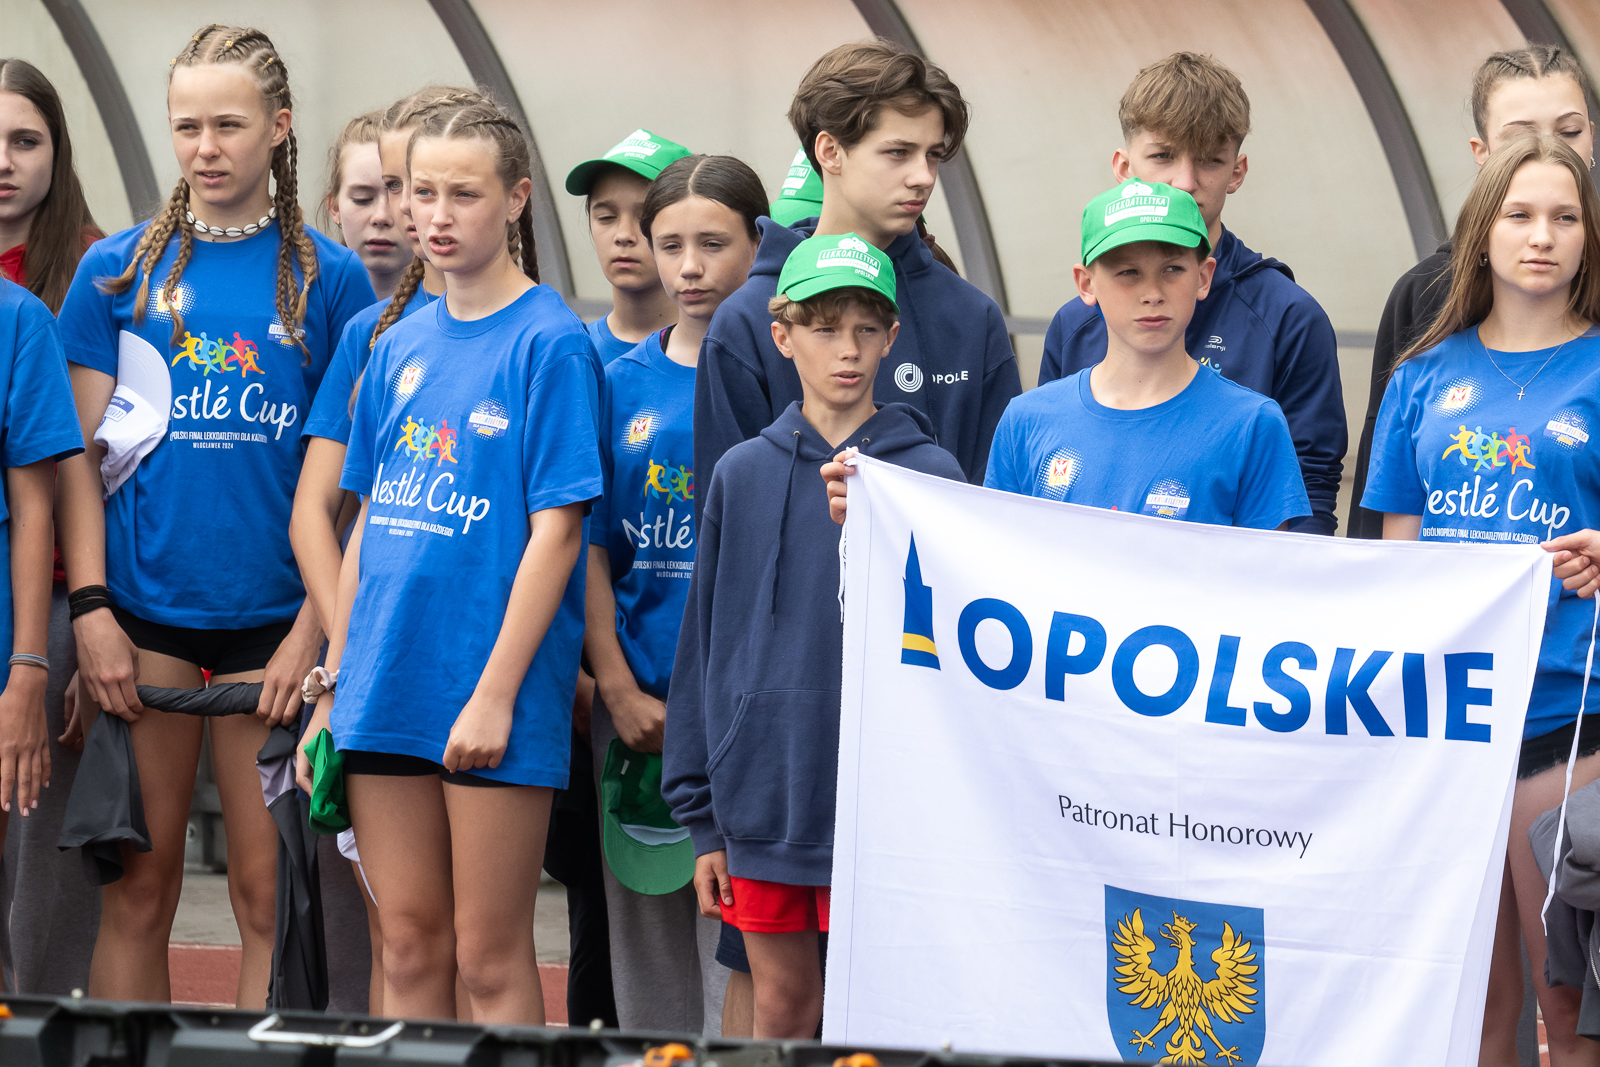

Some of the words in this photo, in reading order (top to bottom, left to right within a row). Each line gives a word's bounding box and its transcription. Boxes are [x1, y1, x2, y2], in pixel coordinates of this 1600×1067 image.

[1107, 196, 1166, 215] LEKKOATLETYKA
[821, 249, 879, 269] LEKKOATLETYKA
[171, 378, 232, 421] stlé
[239, 382, 298, 441] Cup
[427, 472, 491, 535] Cup
[621, 507, 694, 550] Nstlé
[1425, 474, 1500, 519] estlé
[1506, 478, 1571, 542] Cup
[957, 596, 1494, 744] OPOLSKIE
[1058, 794, 1160, 835] Patronat
[1169, 812, 1313, 859] Honorowy
